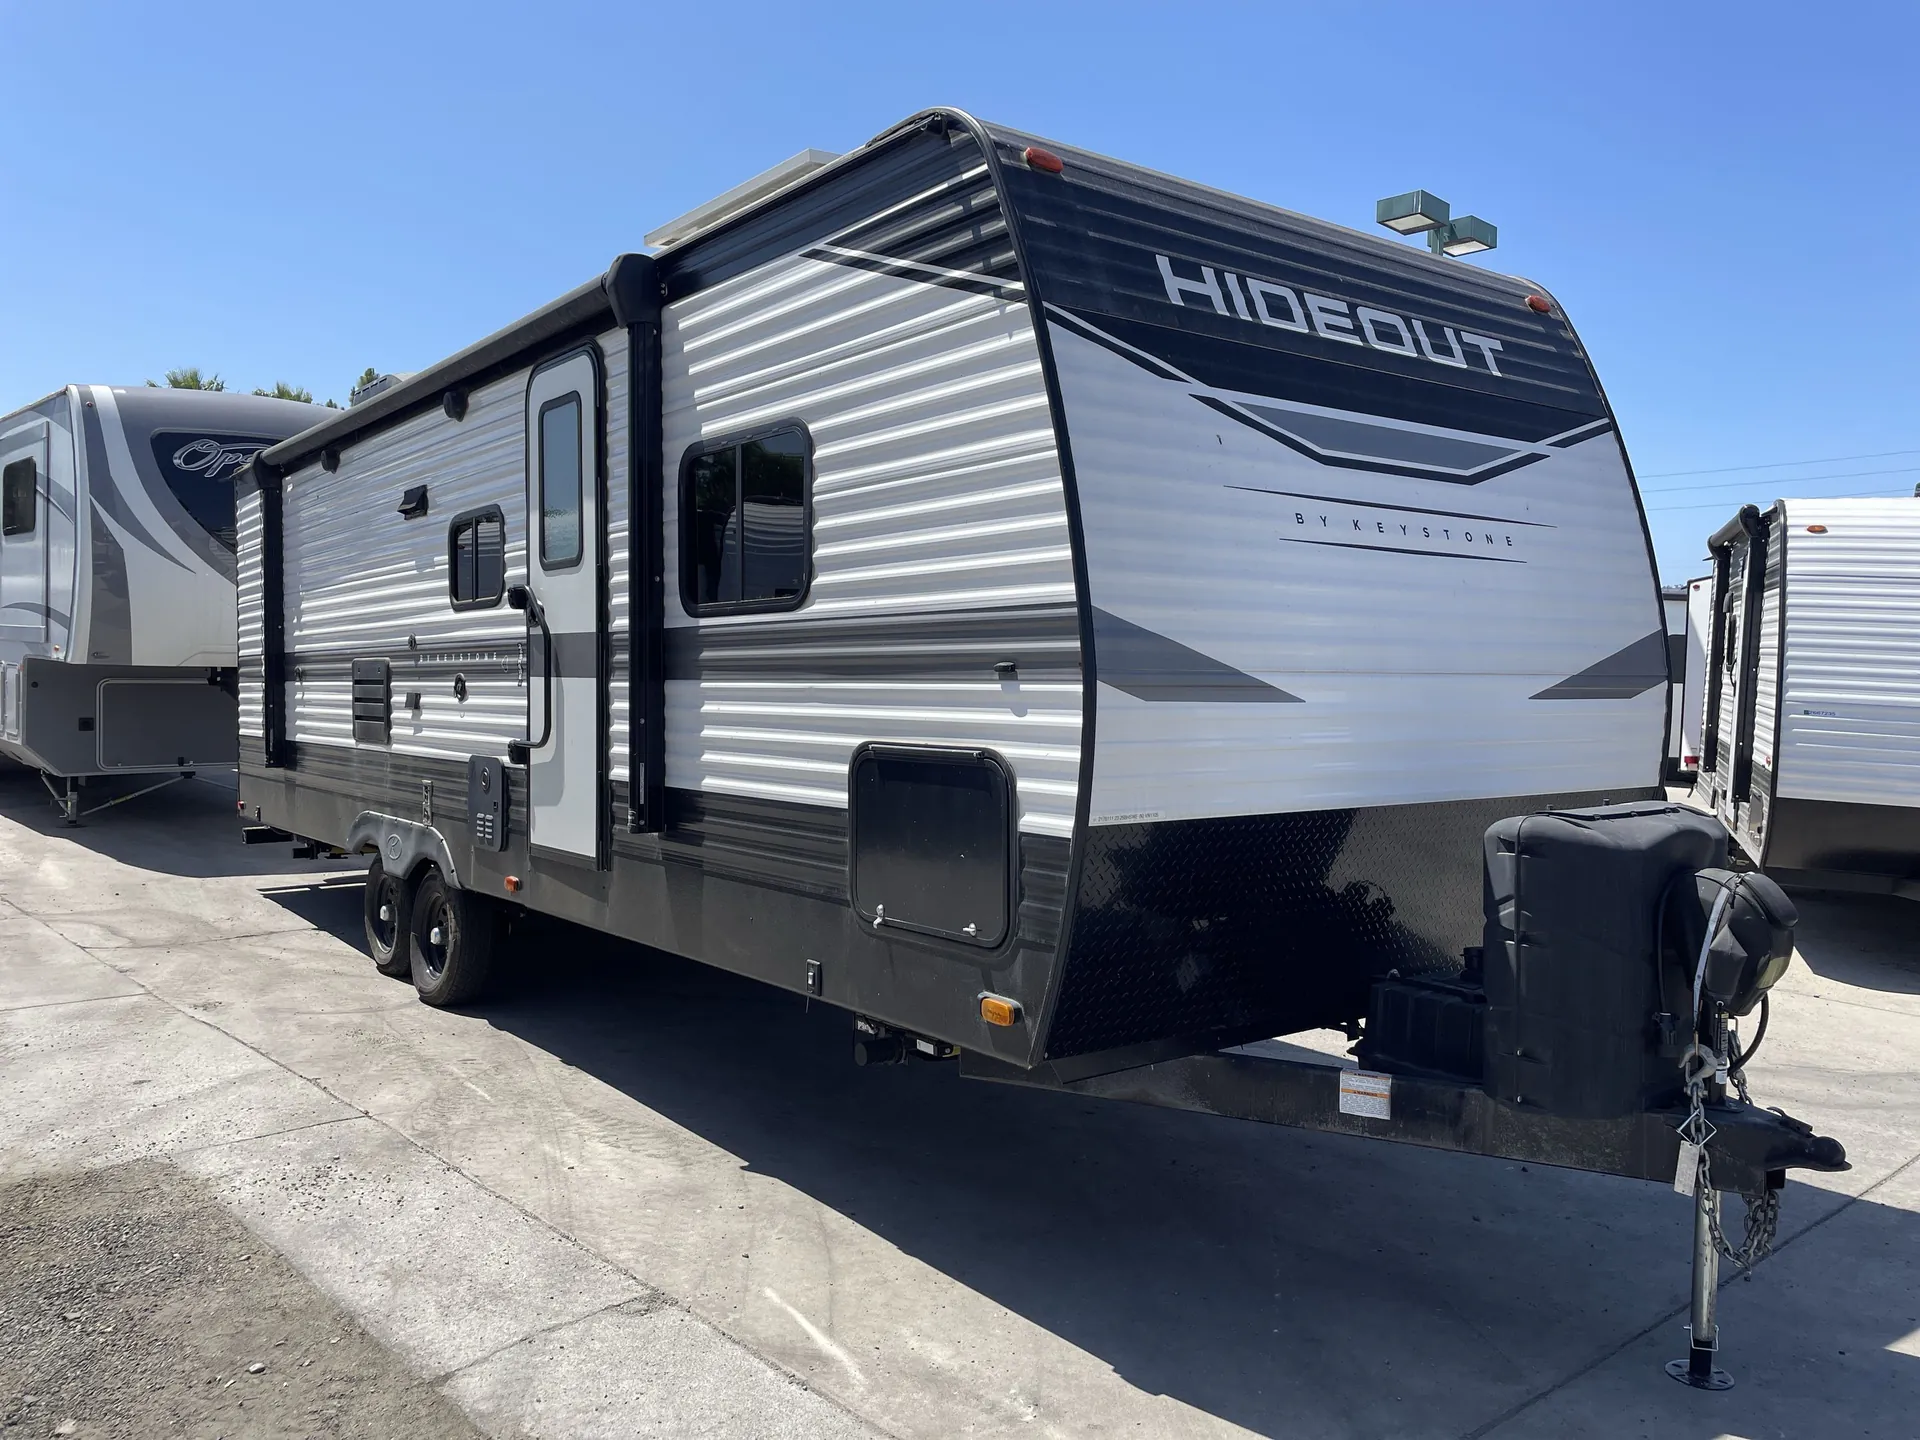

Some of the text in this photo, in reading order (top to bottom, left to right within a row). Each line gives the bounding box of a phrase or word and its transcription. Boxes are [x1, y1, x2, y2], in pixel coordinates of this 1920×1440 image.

[1156, 254, 1503, 377] HIDEOUT
[1295, 513, 1513, 547] BY KEYSTONE
